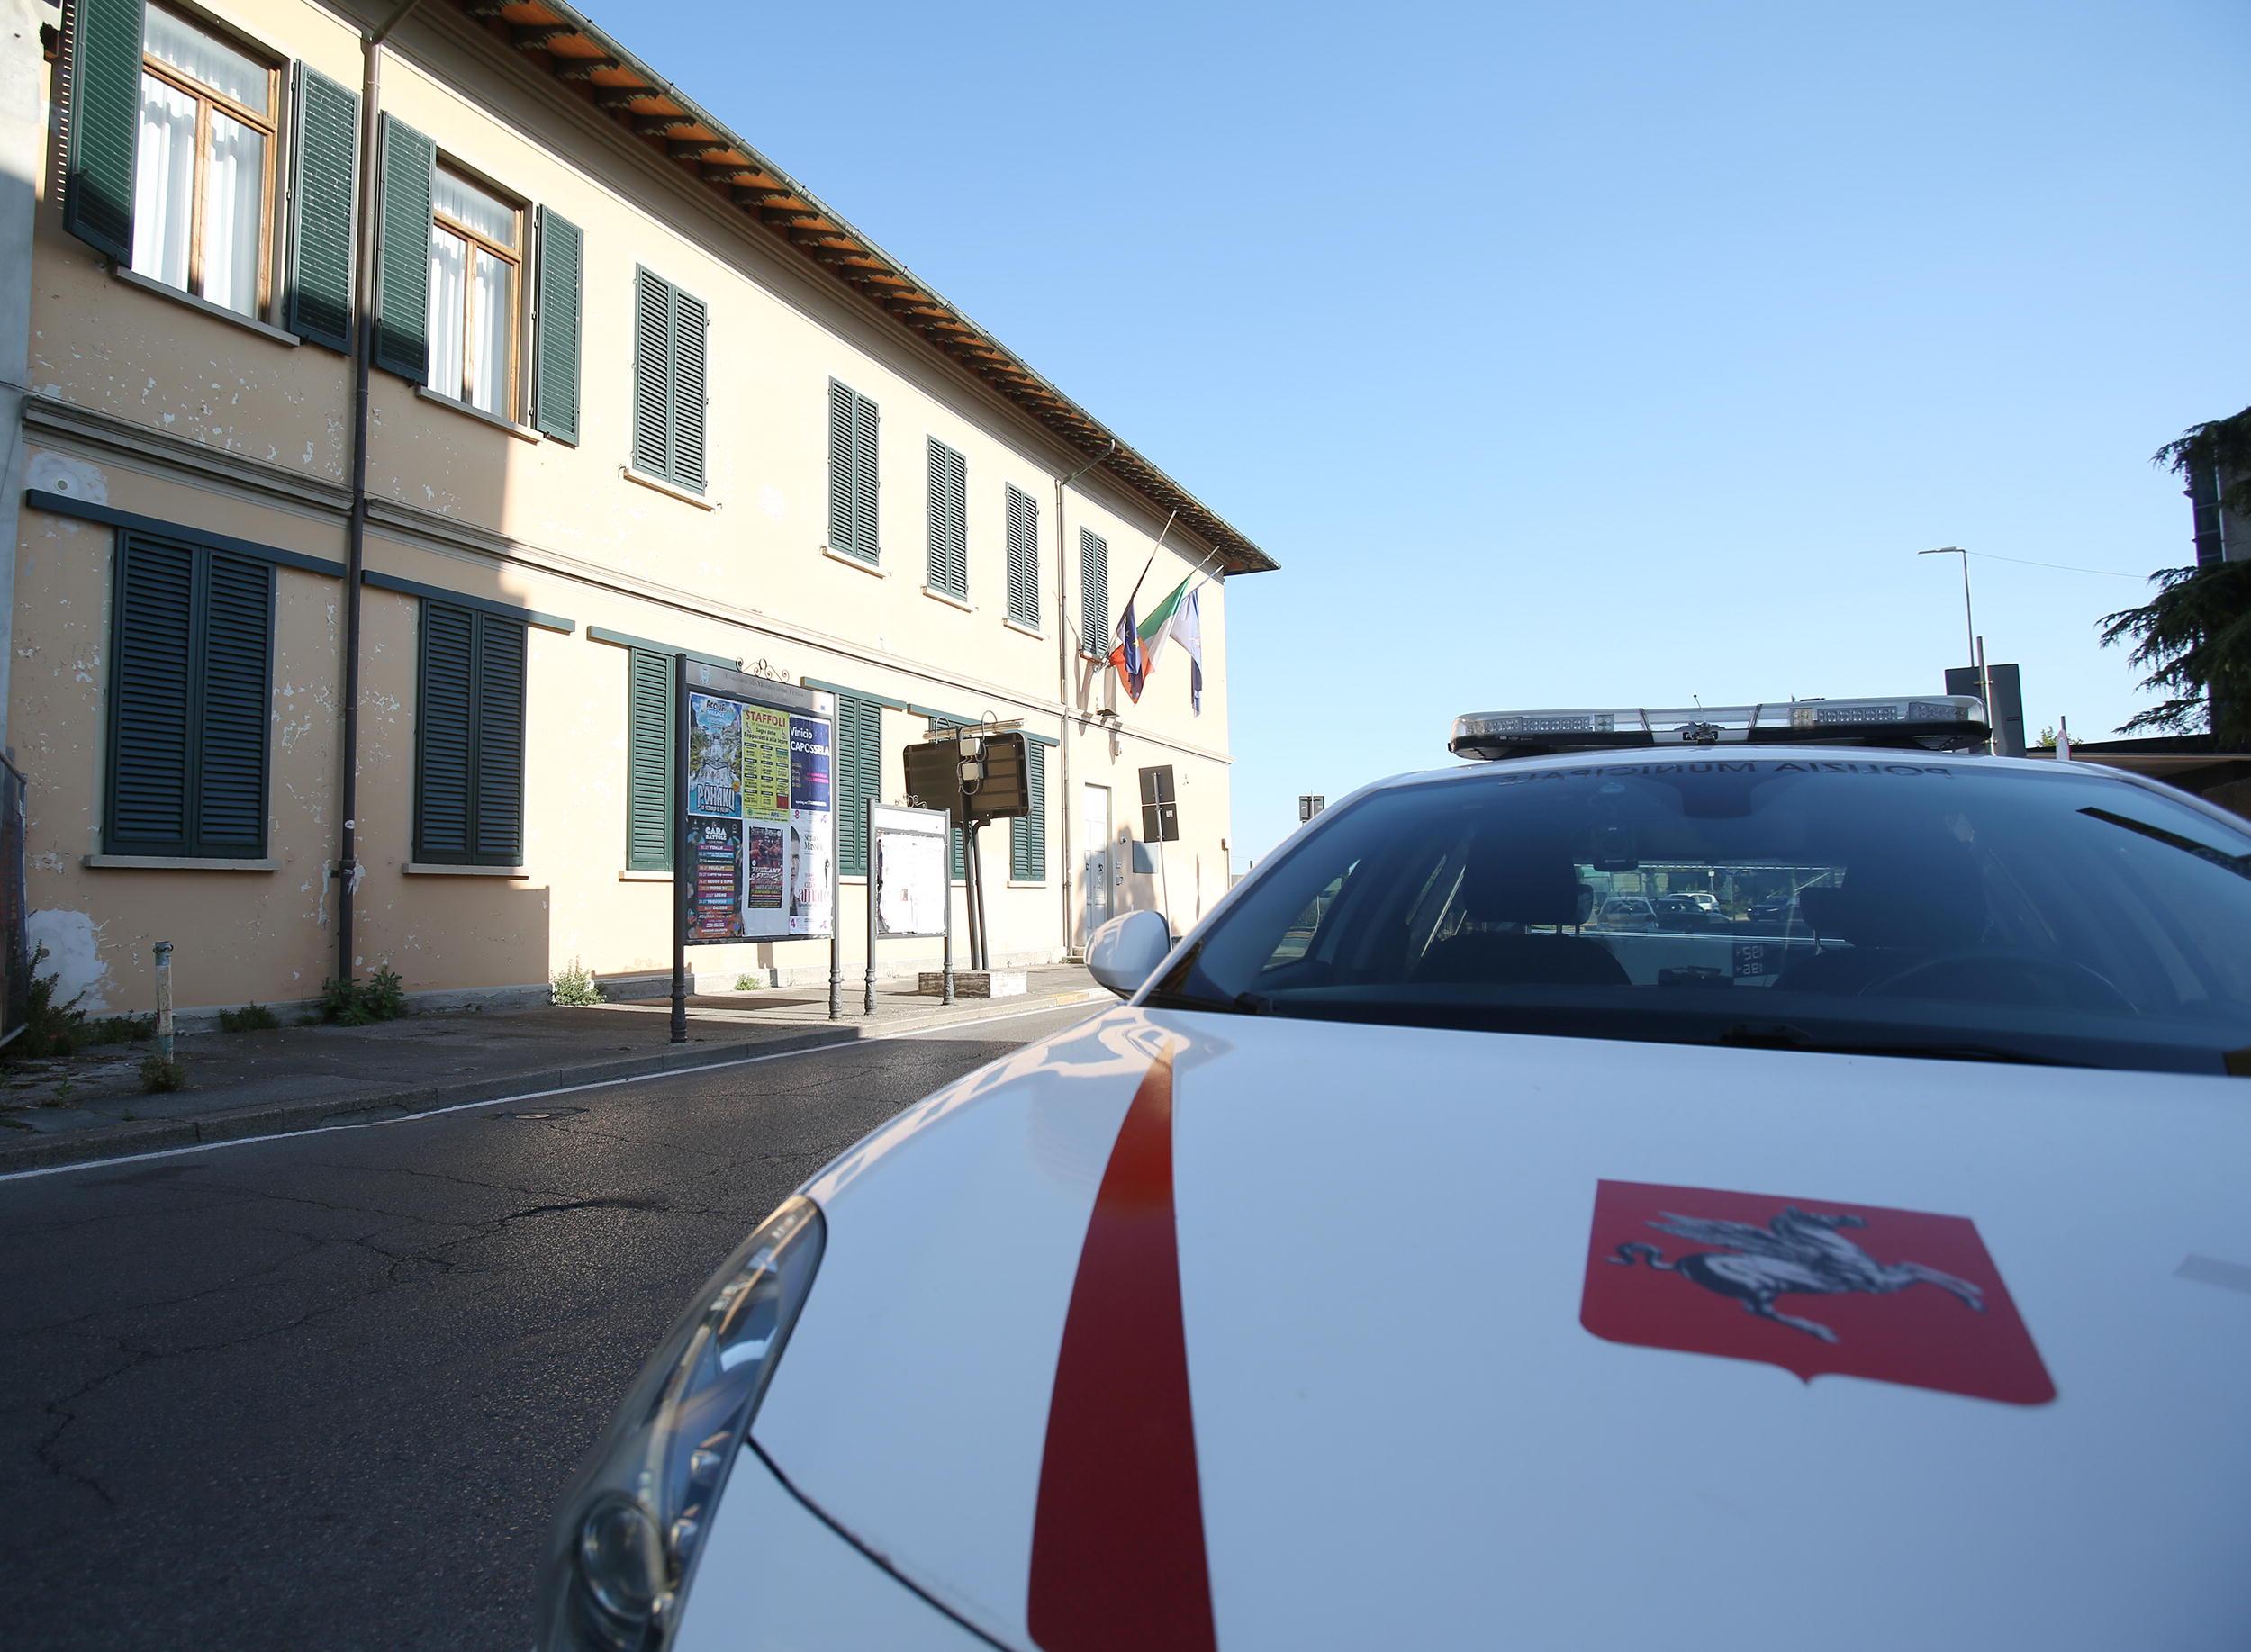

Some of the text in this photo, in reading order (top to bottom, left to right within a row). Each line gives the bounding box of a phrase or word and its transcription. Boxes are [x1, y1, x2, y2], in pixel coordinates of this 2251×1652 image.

[746, 711, 786, 727] STAFFOLI
[790, 726, 812, 739] Vinicio
[790, 740, 829, 756] CAPOSSELA
